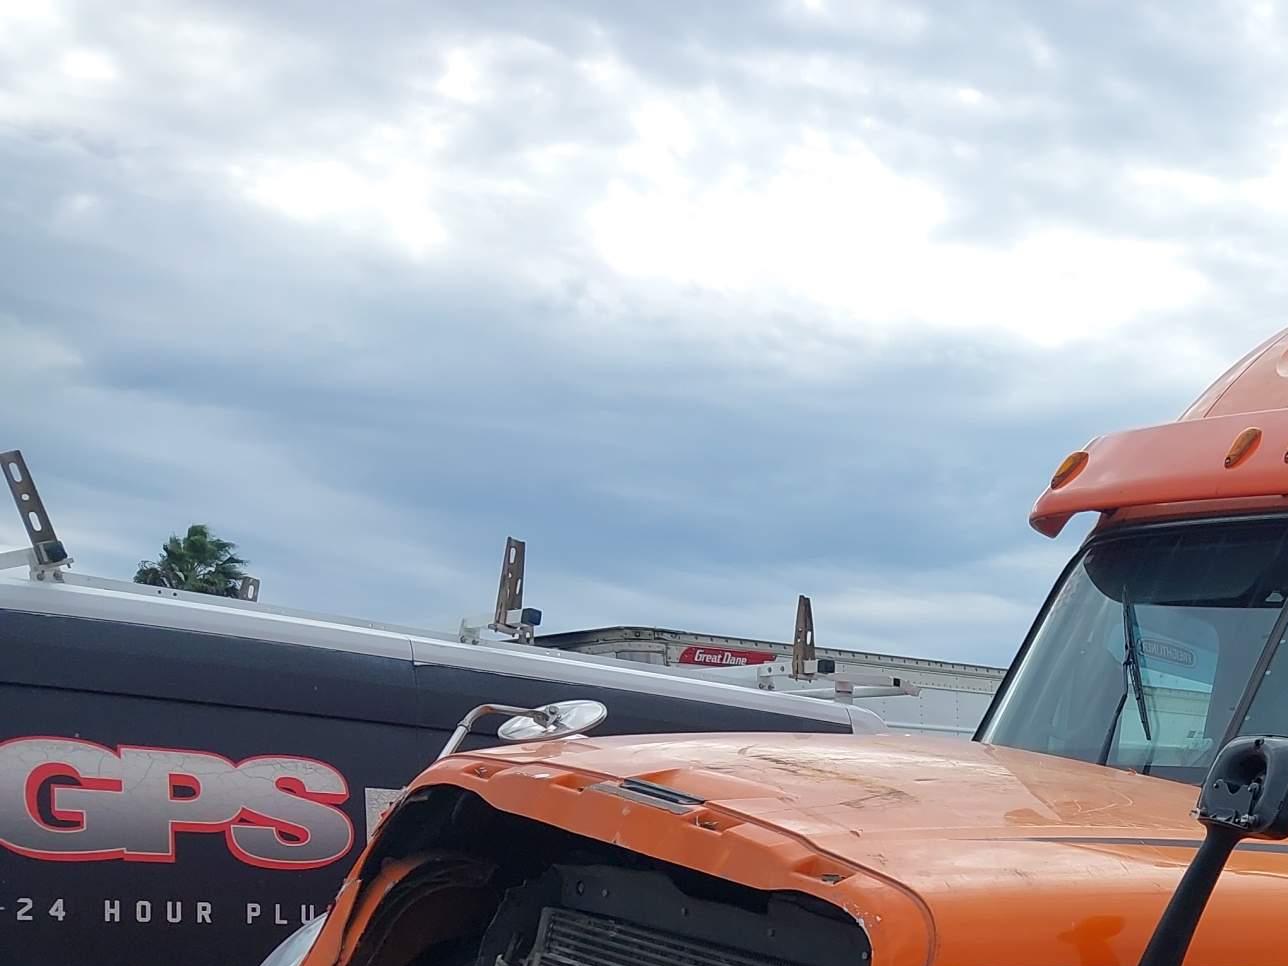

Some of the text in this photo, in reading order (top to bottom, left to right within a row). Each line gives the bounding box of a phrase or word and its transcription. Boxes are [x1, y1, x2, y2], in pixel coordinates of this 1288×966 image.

[694, 649, 748, 665] Great Dane
[0, 736, 354, 870] GPS
[104, 899, 212, 924] HOUR
